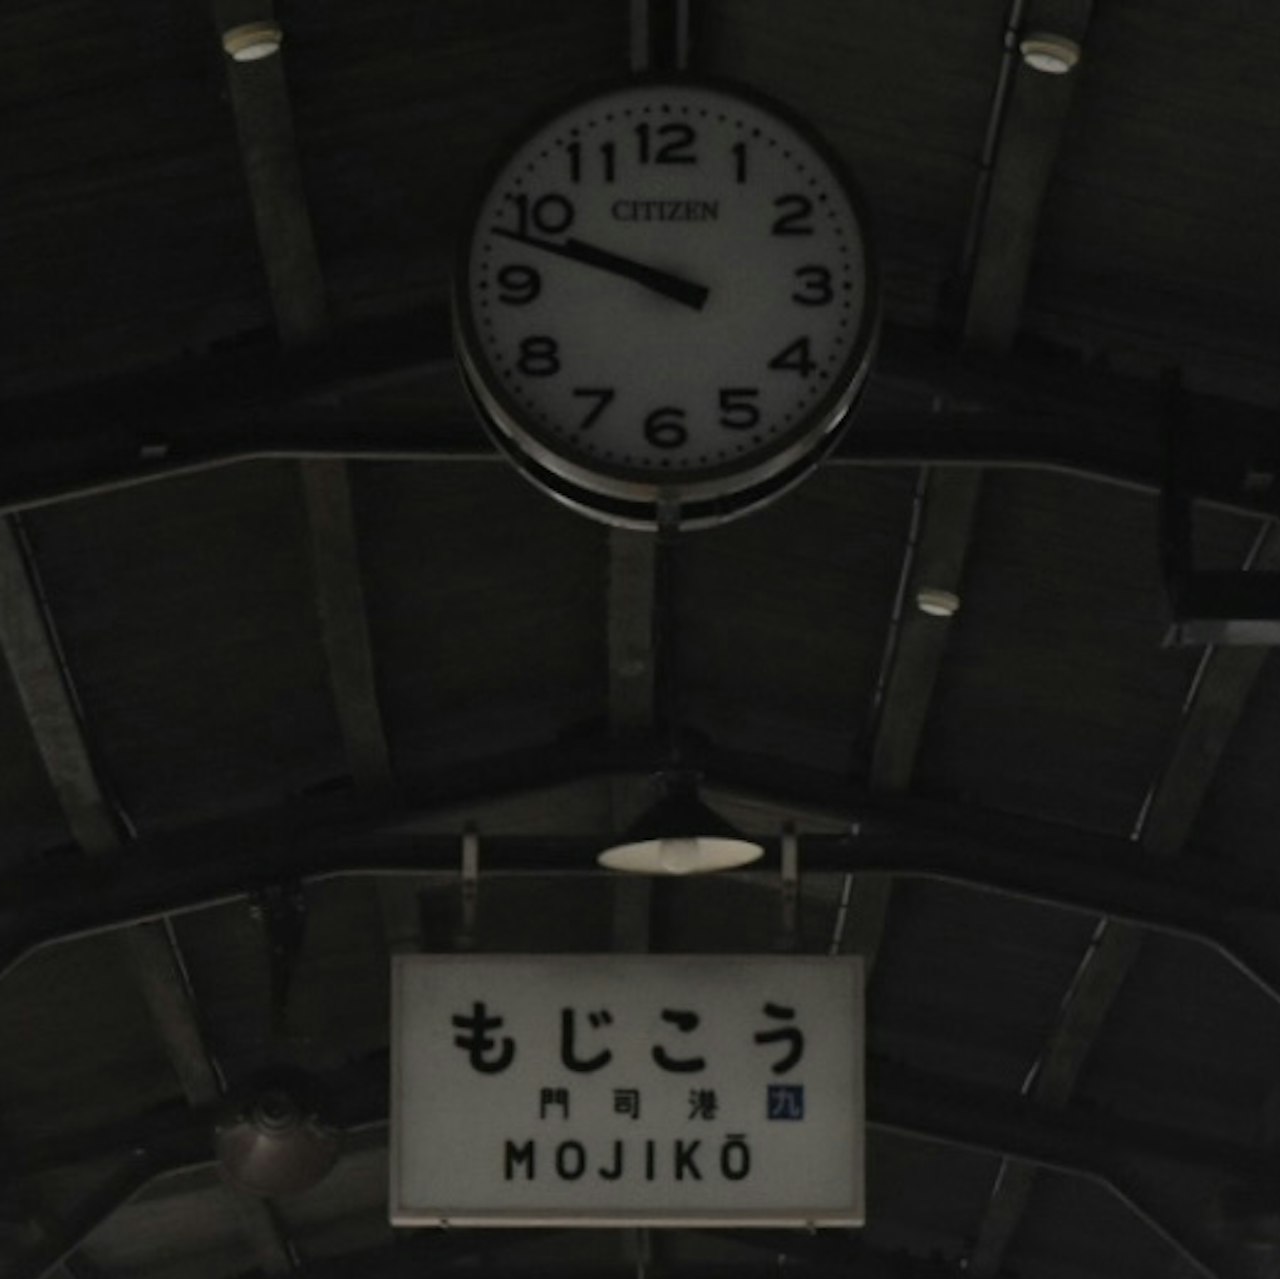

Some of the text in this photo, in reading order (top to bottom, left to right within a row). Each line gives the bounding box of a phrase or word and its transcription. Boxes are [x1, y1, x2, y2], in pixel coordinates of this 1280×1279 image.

[567, 141, 615, 184] 11
[635, 122, 697, 165] 12
[732, 141, 748, 184] 1
[514, 193, 574, 237] 10
[611, 199, 719, 222] CITIZEN
[772, 195, 815, 236] 2
[497, 265, 541, 306] 9
[791, 266, 835, 307] 3
[519, 336, 560, 378] 8
[767, 336, 816, 378] 4
[573, 388, 616, 430] 7
[644, 407, 688, 449] 6
[720, 388, 760, 430] 5
[452, 1002, 805, 1075] もじこう
[540, 1088, 718, 1120] 門司港
